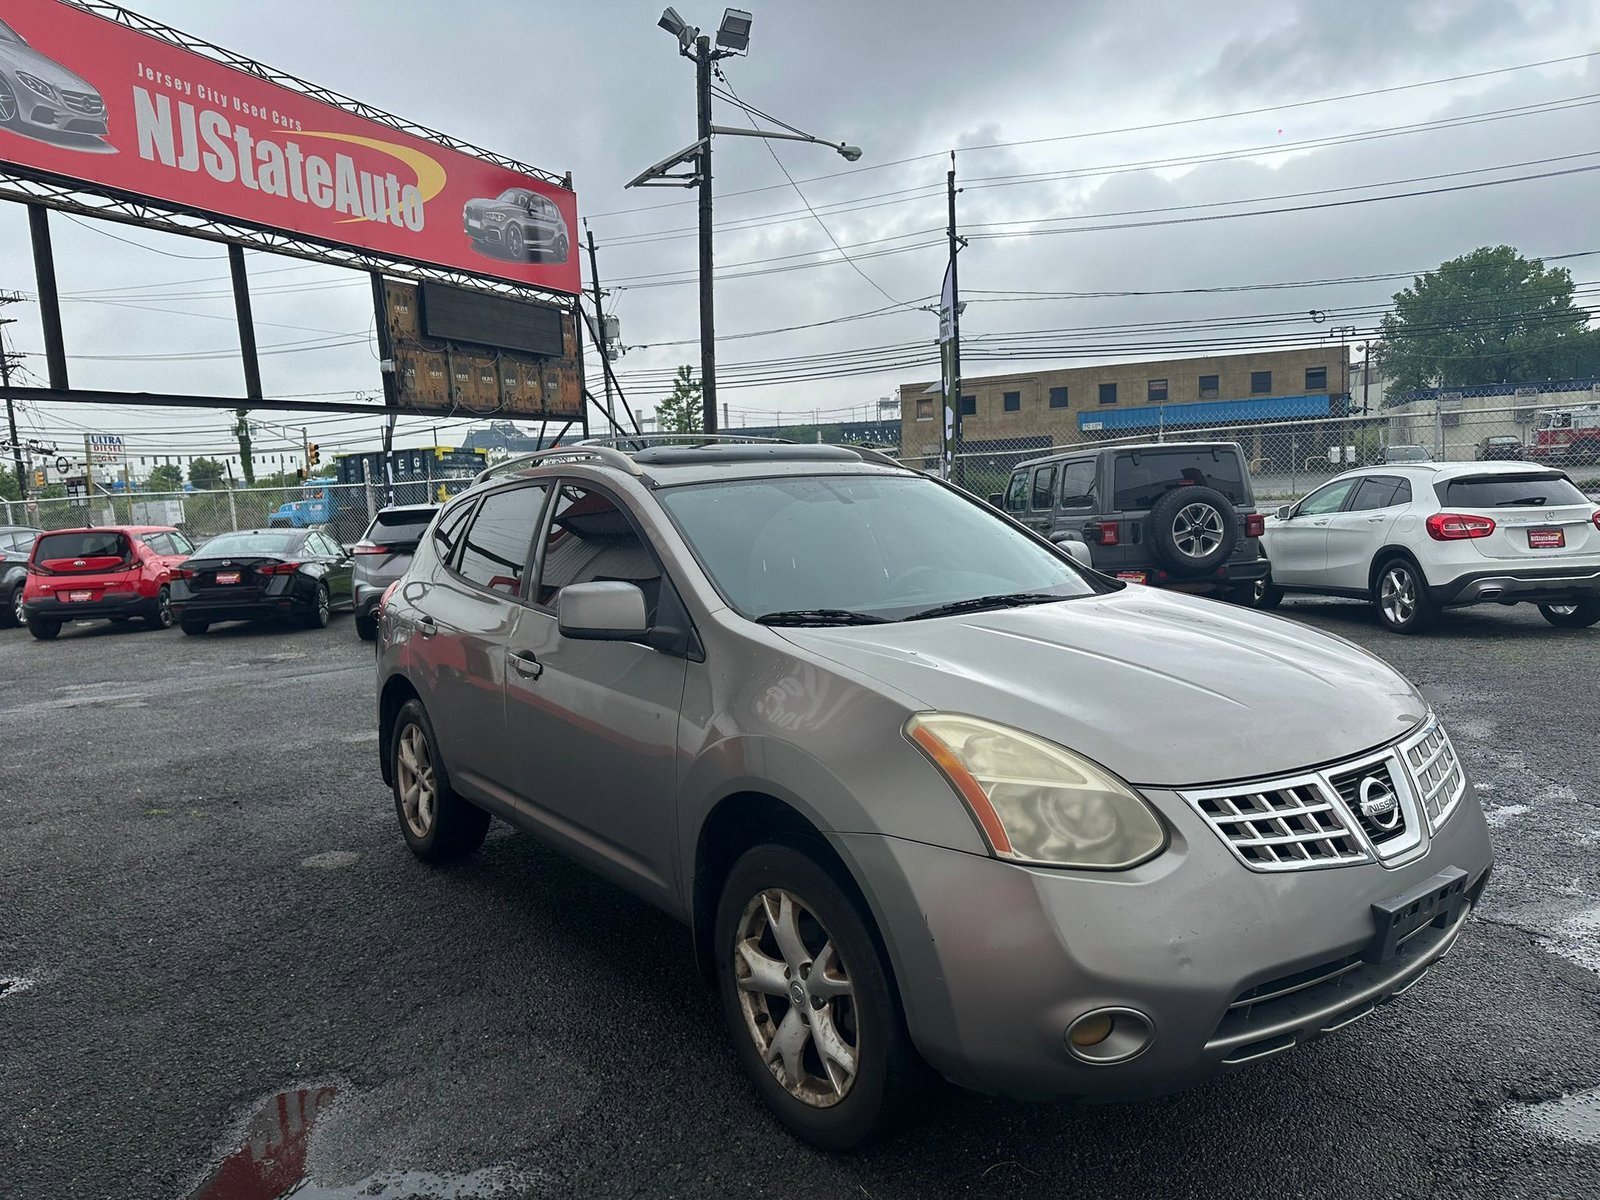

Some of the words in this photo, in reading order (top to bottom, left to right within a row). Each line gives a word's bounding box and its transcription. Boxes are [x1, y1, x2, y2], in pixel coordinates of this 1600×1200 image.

[137, 62, 192, 95] Jersey
[197, 84, 228, 108] City
[233, 96, 267, 120] Used
[272, 110, 302, 131] Cars
[132, 85, 425, 233] NJStateAuto
[91, 435, 122, 444] ULTRA
[93, 444, 122, 452] DIESEL
